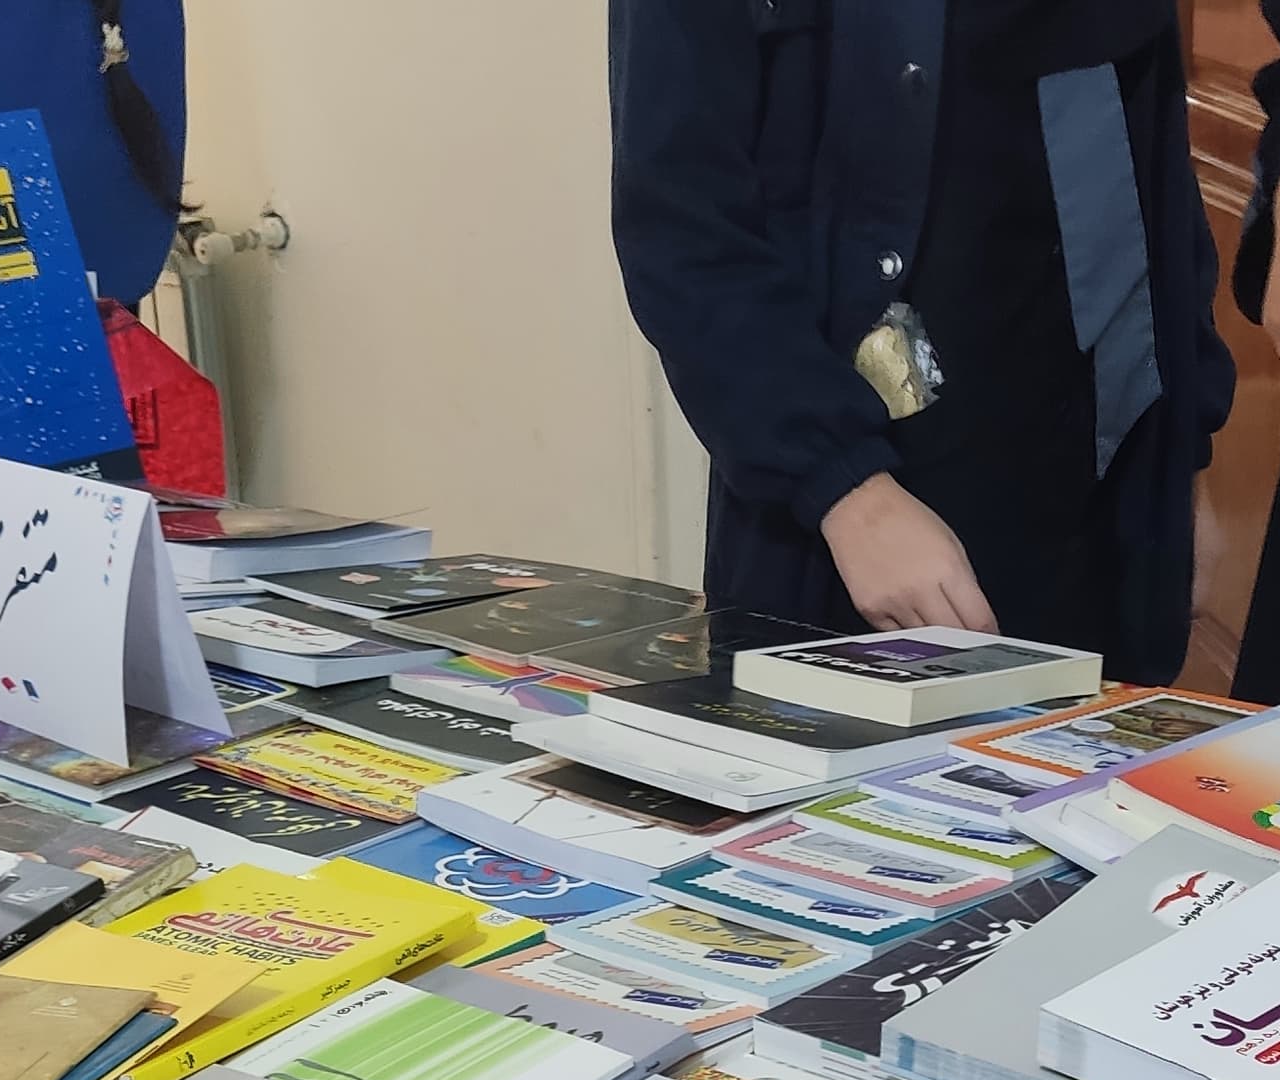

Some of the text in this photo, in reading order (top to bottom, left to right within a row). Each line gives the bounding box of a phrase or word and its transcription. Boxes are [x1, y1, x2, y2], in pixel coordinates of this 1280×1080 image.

[147, 924, 305, 966] ATOMIC HABITS
[1153, 971, 1208, 1021] تیزهوشان
[1218, 961, 1253, 991] دولتی
